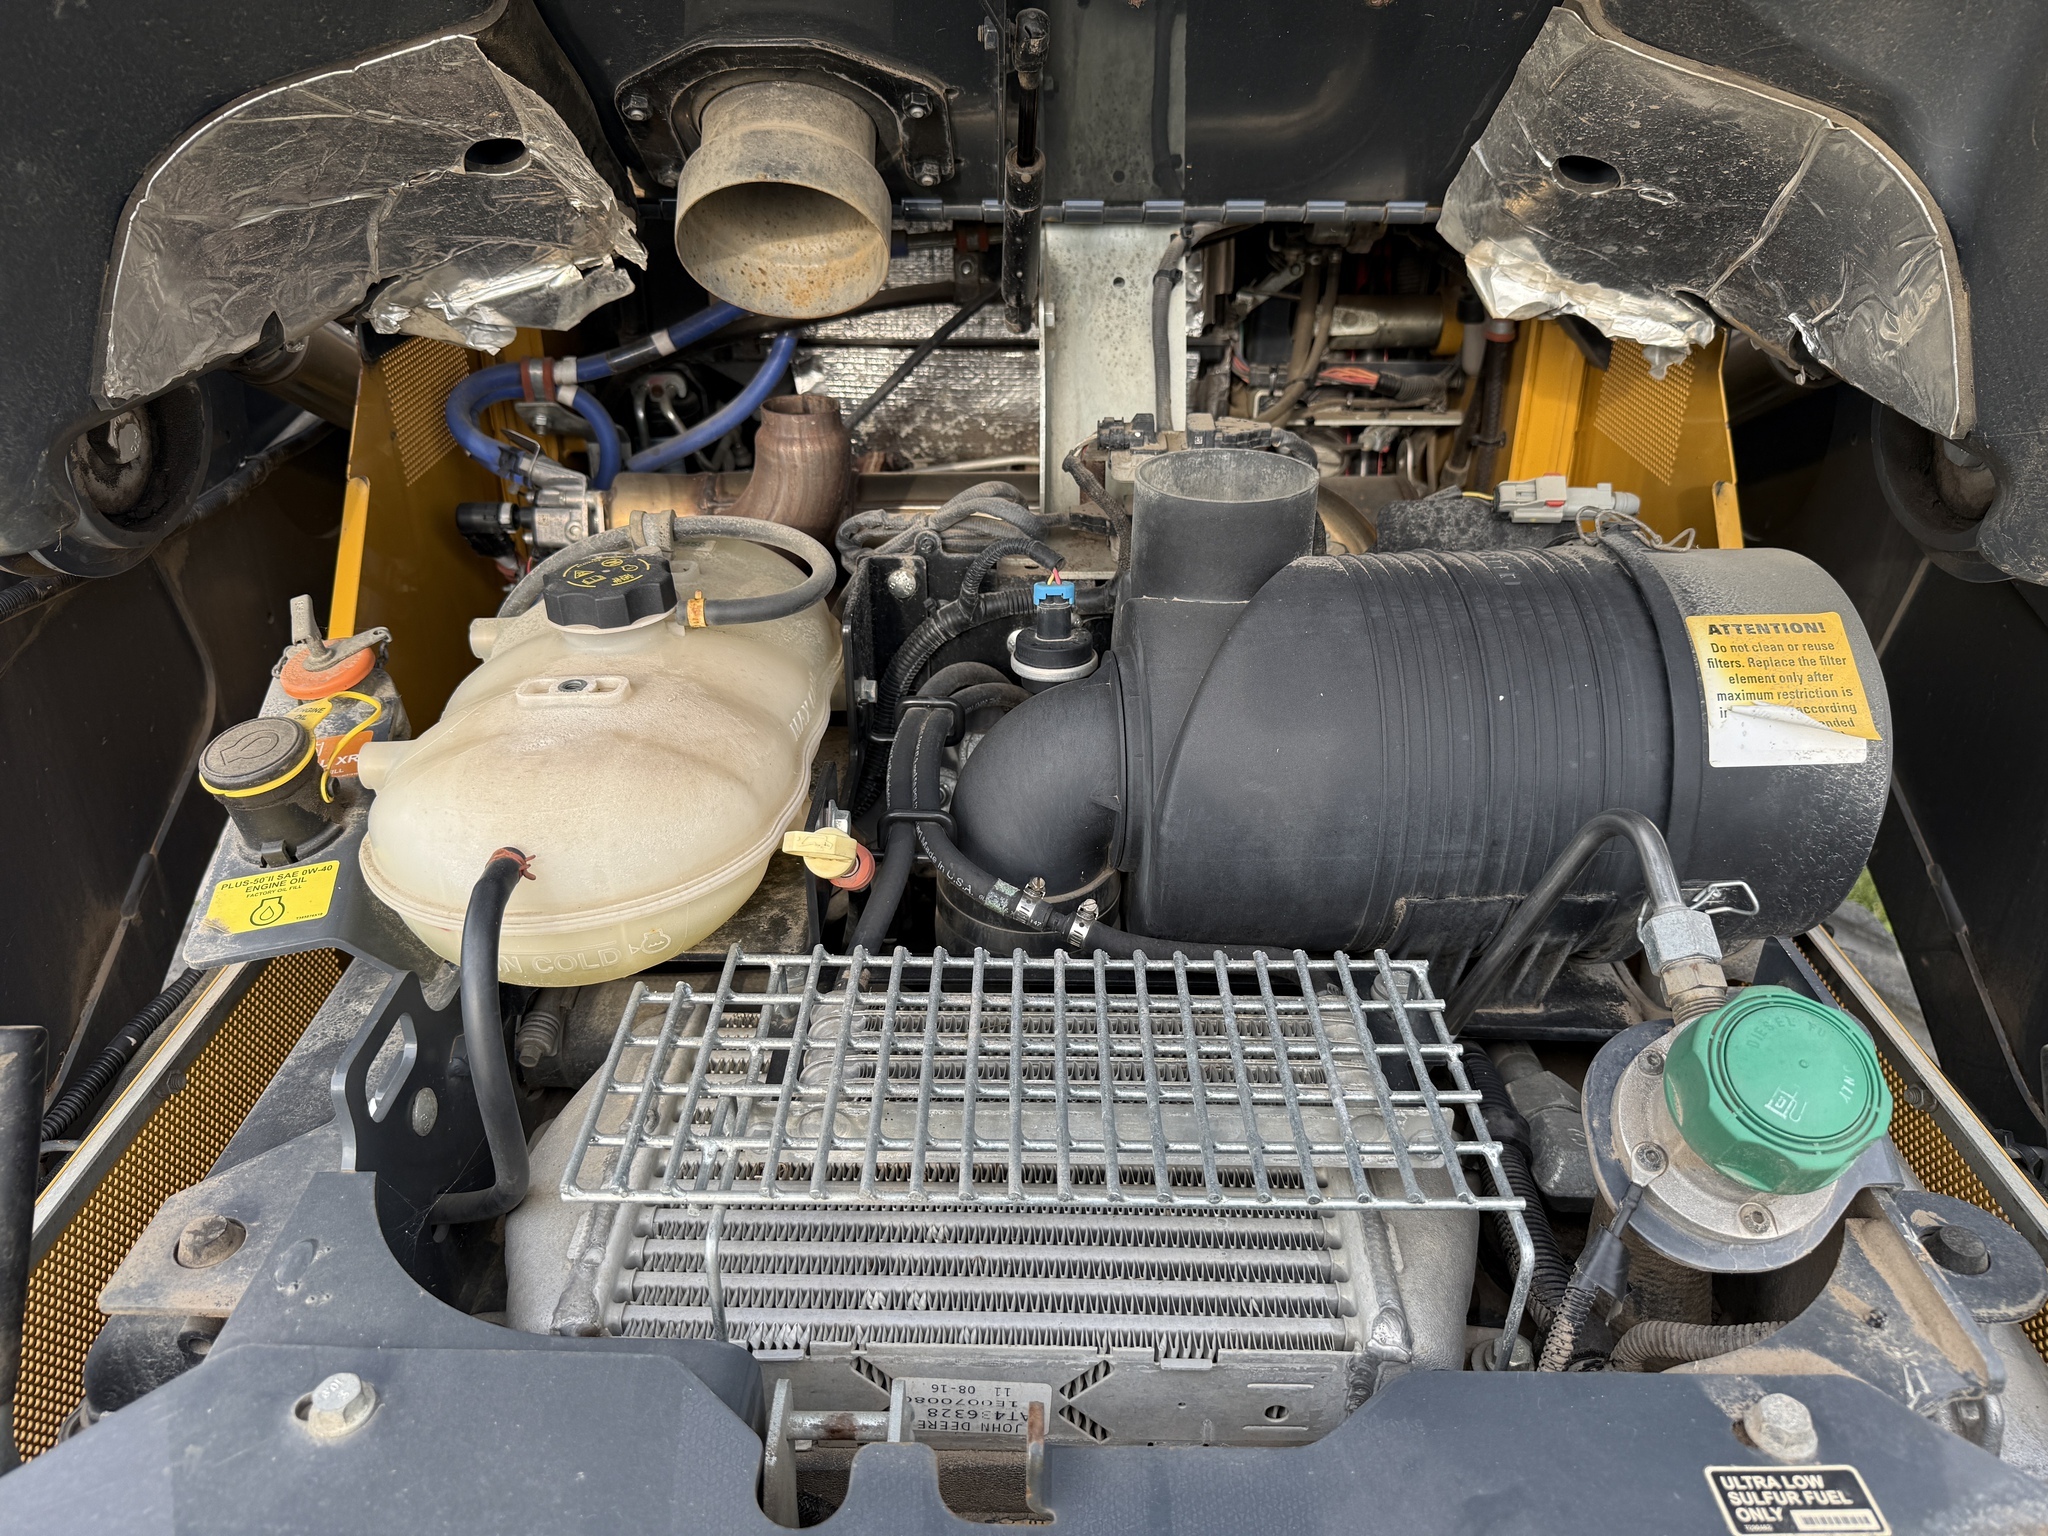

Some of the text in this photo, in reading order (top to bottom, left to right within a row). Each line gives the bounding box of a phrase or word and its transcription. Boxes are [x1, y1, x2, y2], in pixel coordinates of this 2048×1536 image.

[1708, 622, 1826, 636] ATTENTION!
[1711, 642, 1835, 654] Do not clean or reuse
[1707, 655, 1847, 670] filters. Replace the filter
[1729, 671, 1834, 685] element only after
[1717, 687, 1853, 701] maximum restriction is
[277, 871, 299, 881] SAE
[302, 864, 332, 875] 0W-40
[920, 838, 937, 863] Made
[946, 869, 974, 896] U.S.A.
[245, 877, 307, 893] ENGINE OIL
[246, 889, 275, 898] FACTORY
[532, 947, 622, 974] COLD
[1746, 1015, 1797, 1050] DIESEL
[931, 1384, 1011, 1397] 11 08-16
[927, 1408, 1028, 1422] AT436328
[918, 1419, 1023, 1434] JOHN DEERE
[1719, 1474, 1825, 1491] ULTRA LOW
[1727, 1489, 1854, 1507] SULFUR FUEL
[1735, 1507, 1784, 1523] ONLY
